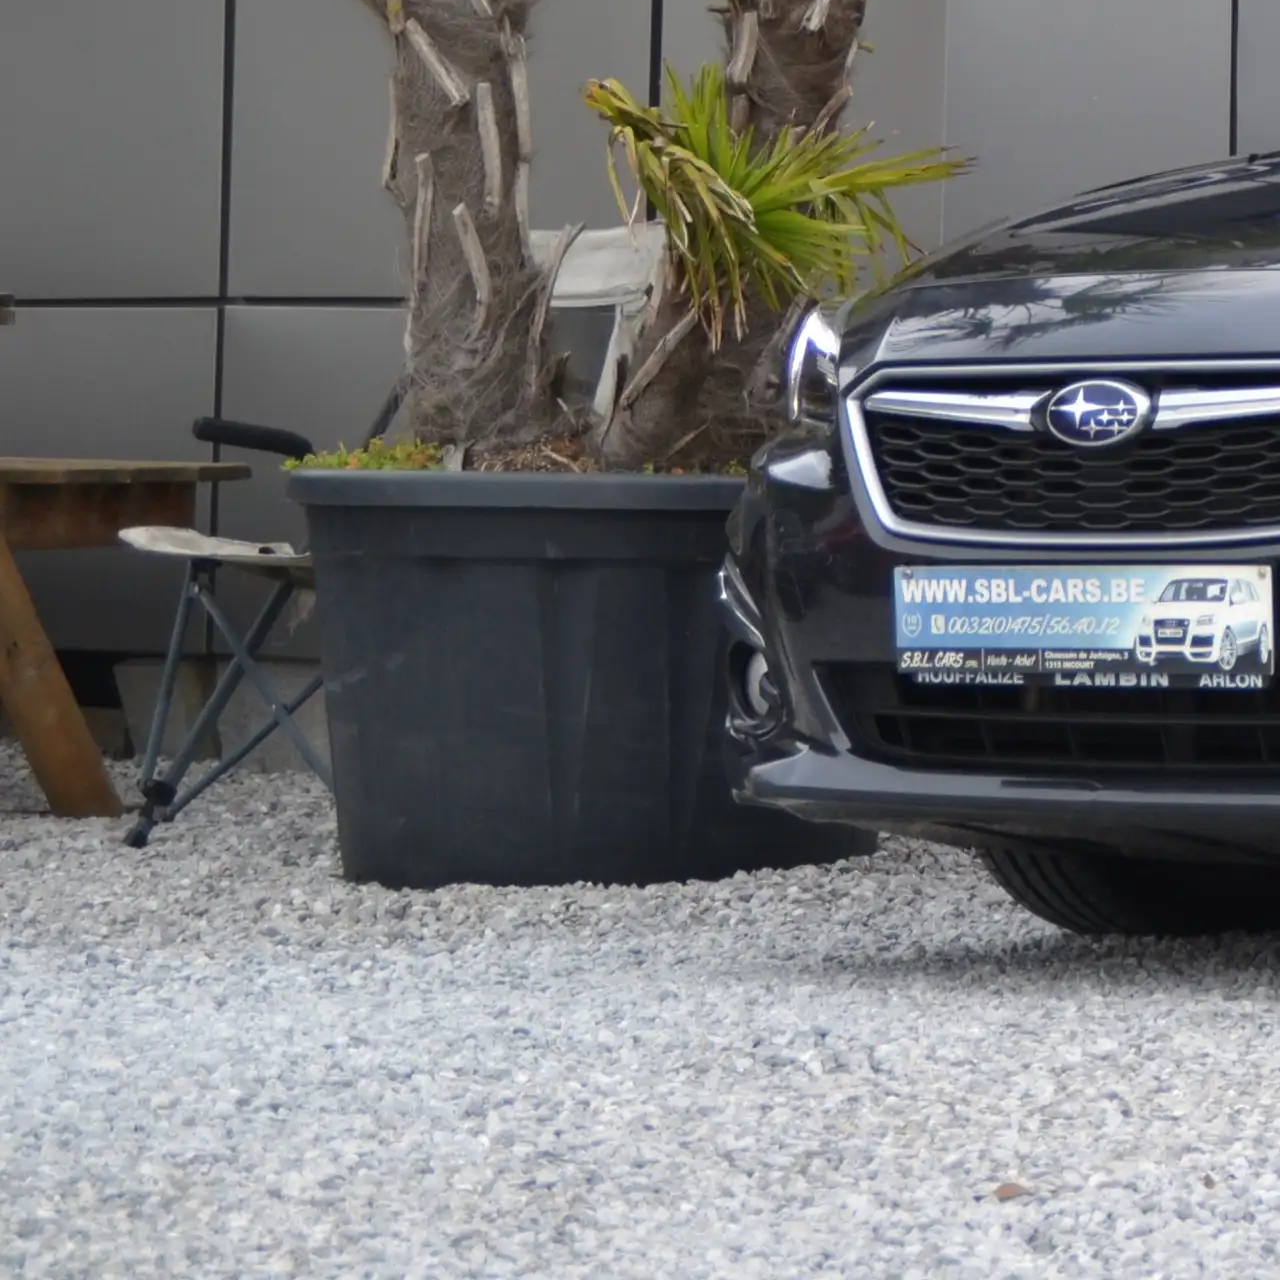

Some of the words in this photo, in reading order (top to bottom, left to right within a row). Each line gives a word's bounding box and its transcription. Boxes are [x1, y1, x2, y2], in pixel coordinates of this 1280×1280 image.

[901, 578, 1147, 604] WWW.SBL-CARS.BE
[934, 651, 965, 668] CARS
[1054, 672, 1170, 687] LAMBIN
[1199, 673, 1263, 689] ARLON
